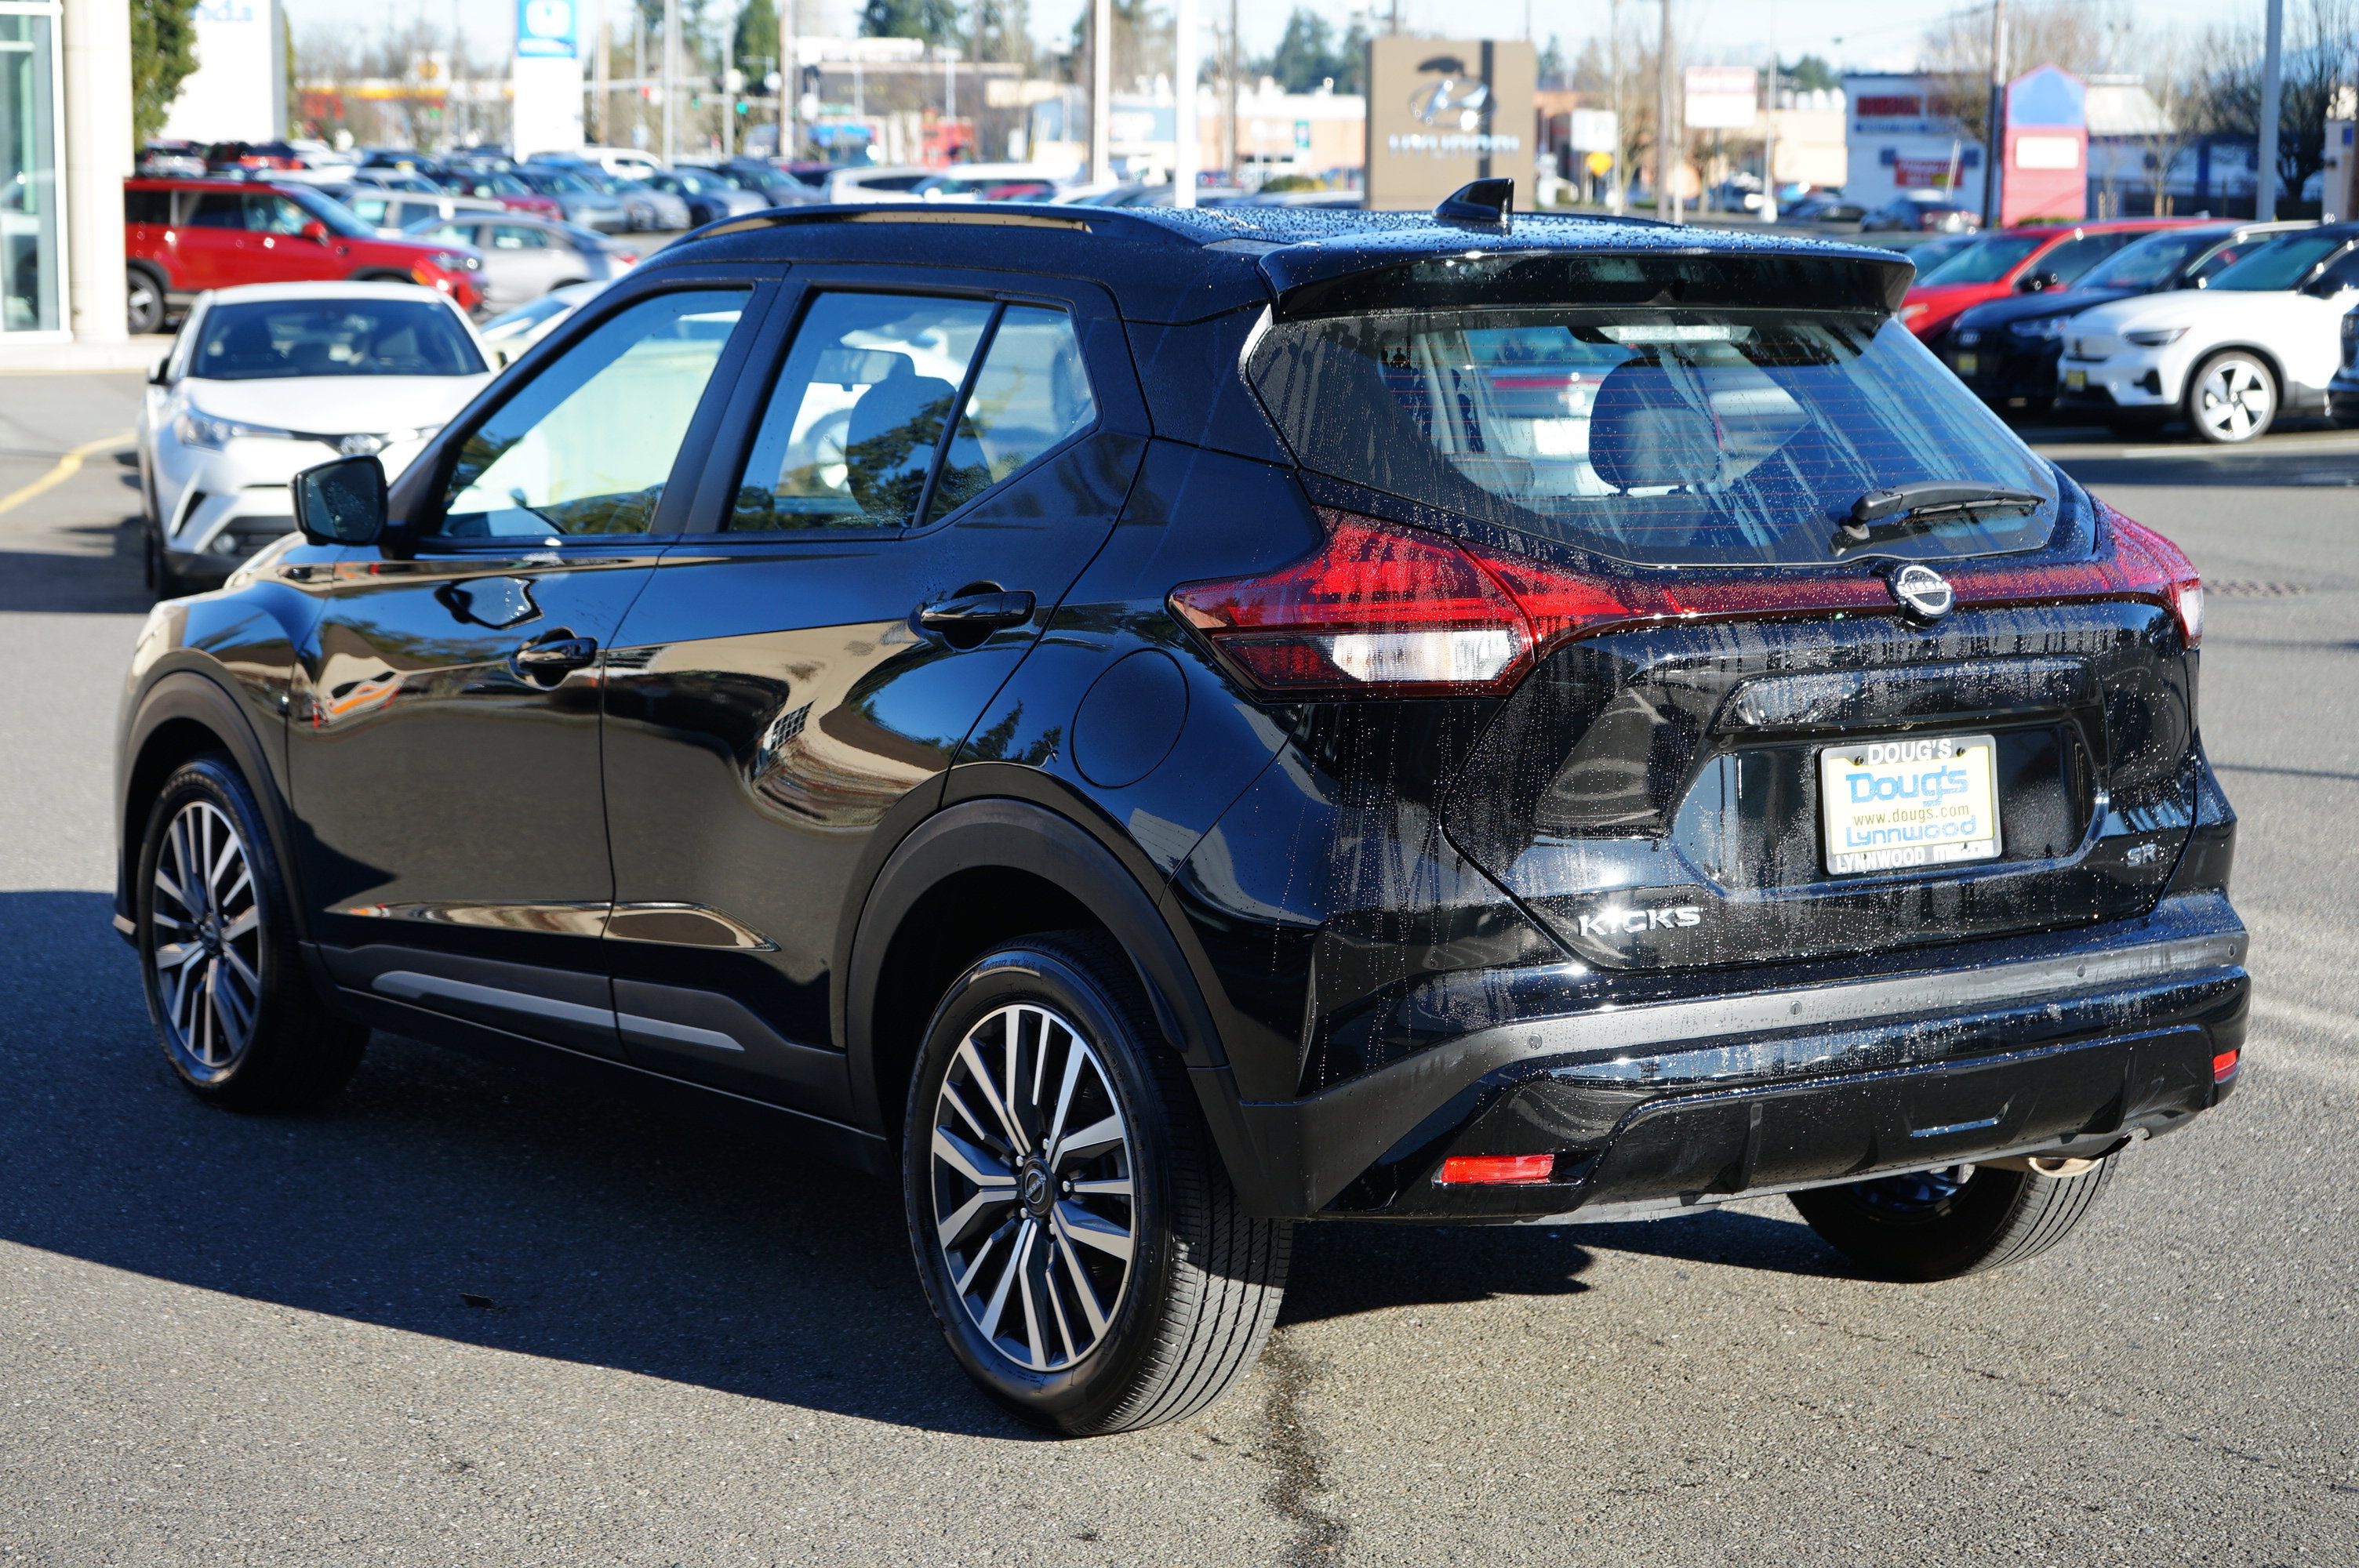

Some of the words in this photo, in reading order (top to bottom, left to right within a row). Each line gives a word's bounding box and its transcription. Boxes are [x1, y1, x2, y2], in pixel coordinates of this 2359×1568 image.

[1896, 581, 1953, 595] NISSAN
[1867, 739, 1952, 765] DOUG'S
[1853, 804, 1970, 826] www.dougs.com
[1845, 815, 1977, 848] Lynnwood
[1835, 846, 1926, 873] LYNNWOOD
[2126, 844, 2157, 867] SR
[1578, 906, 1701, 937] KICKS
